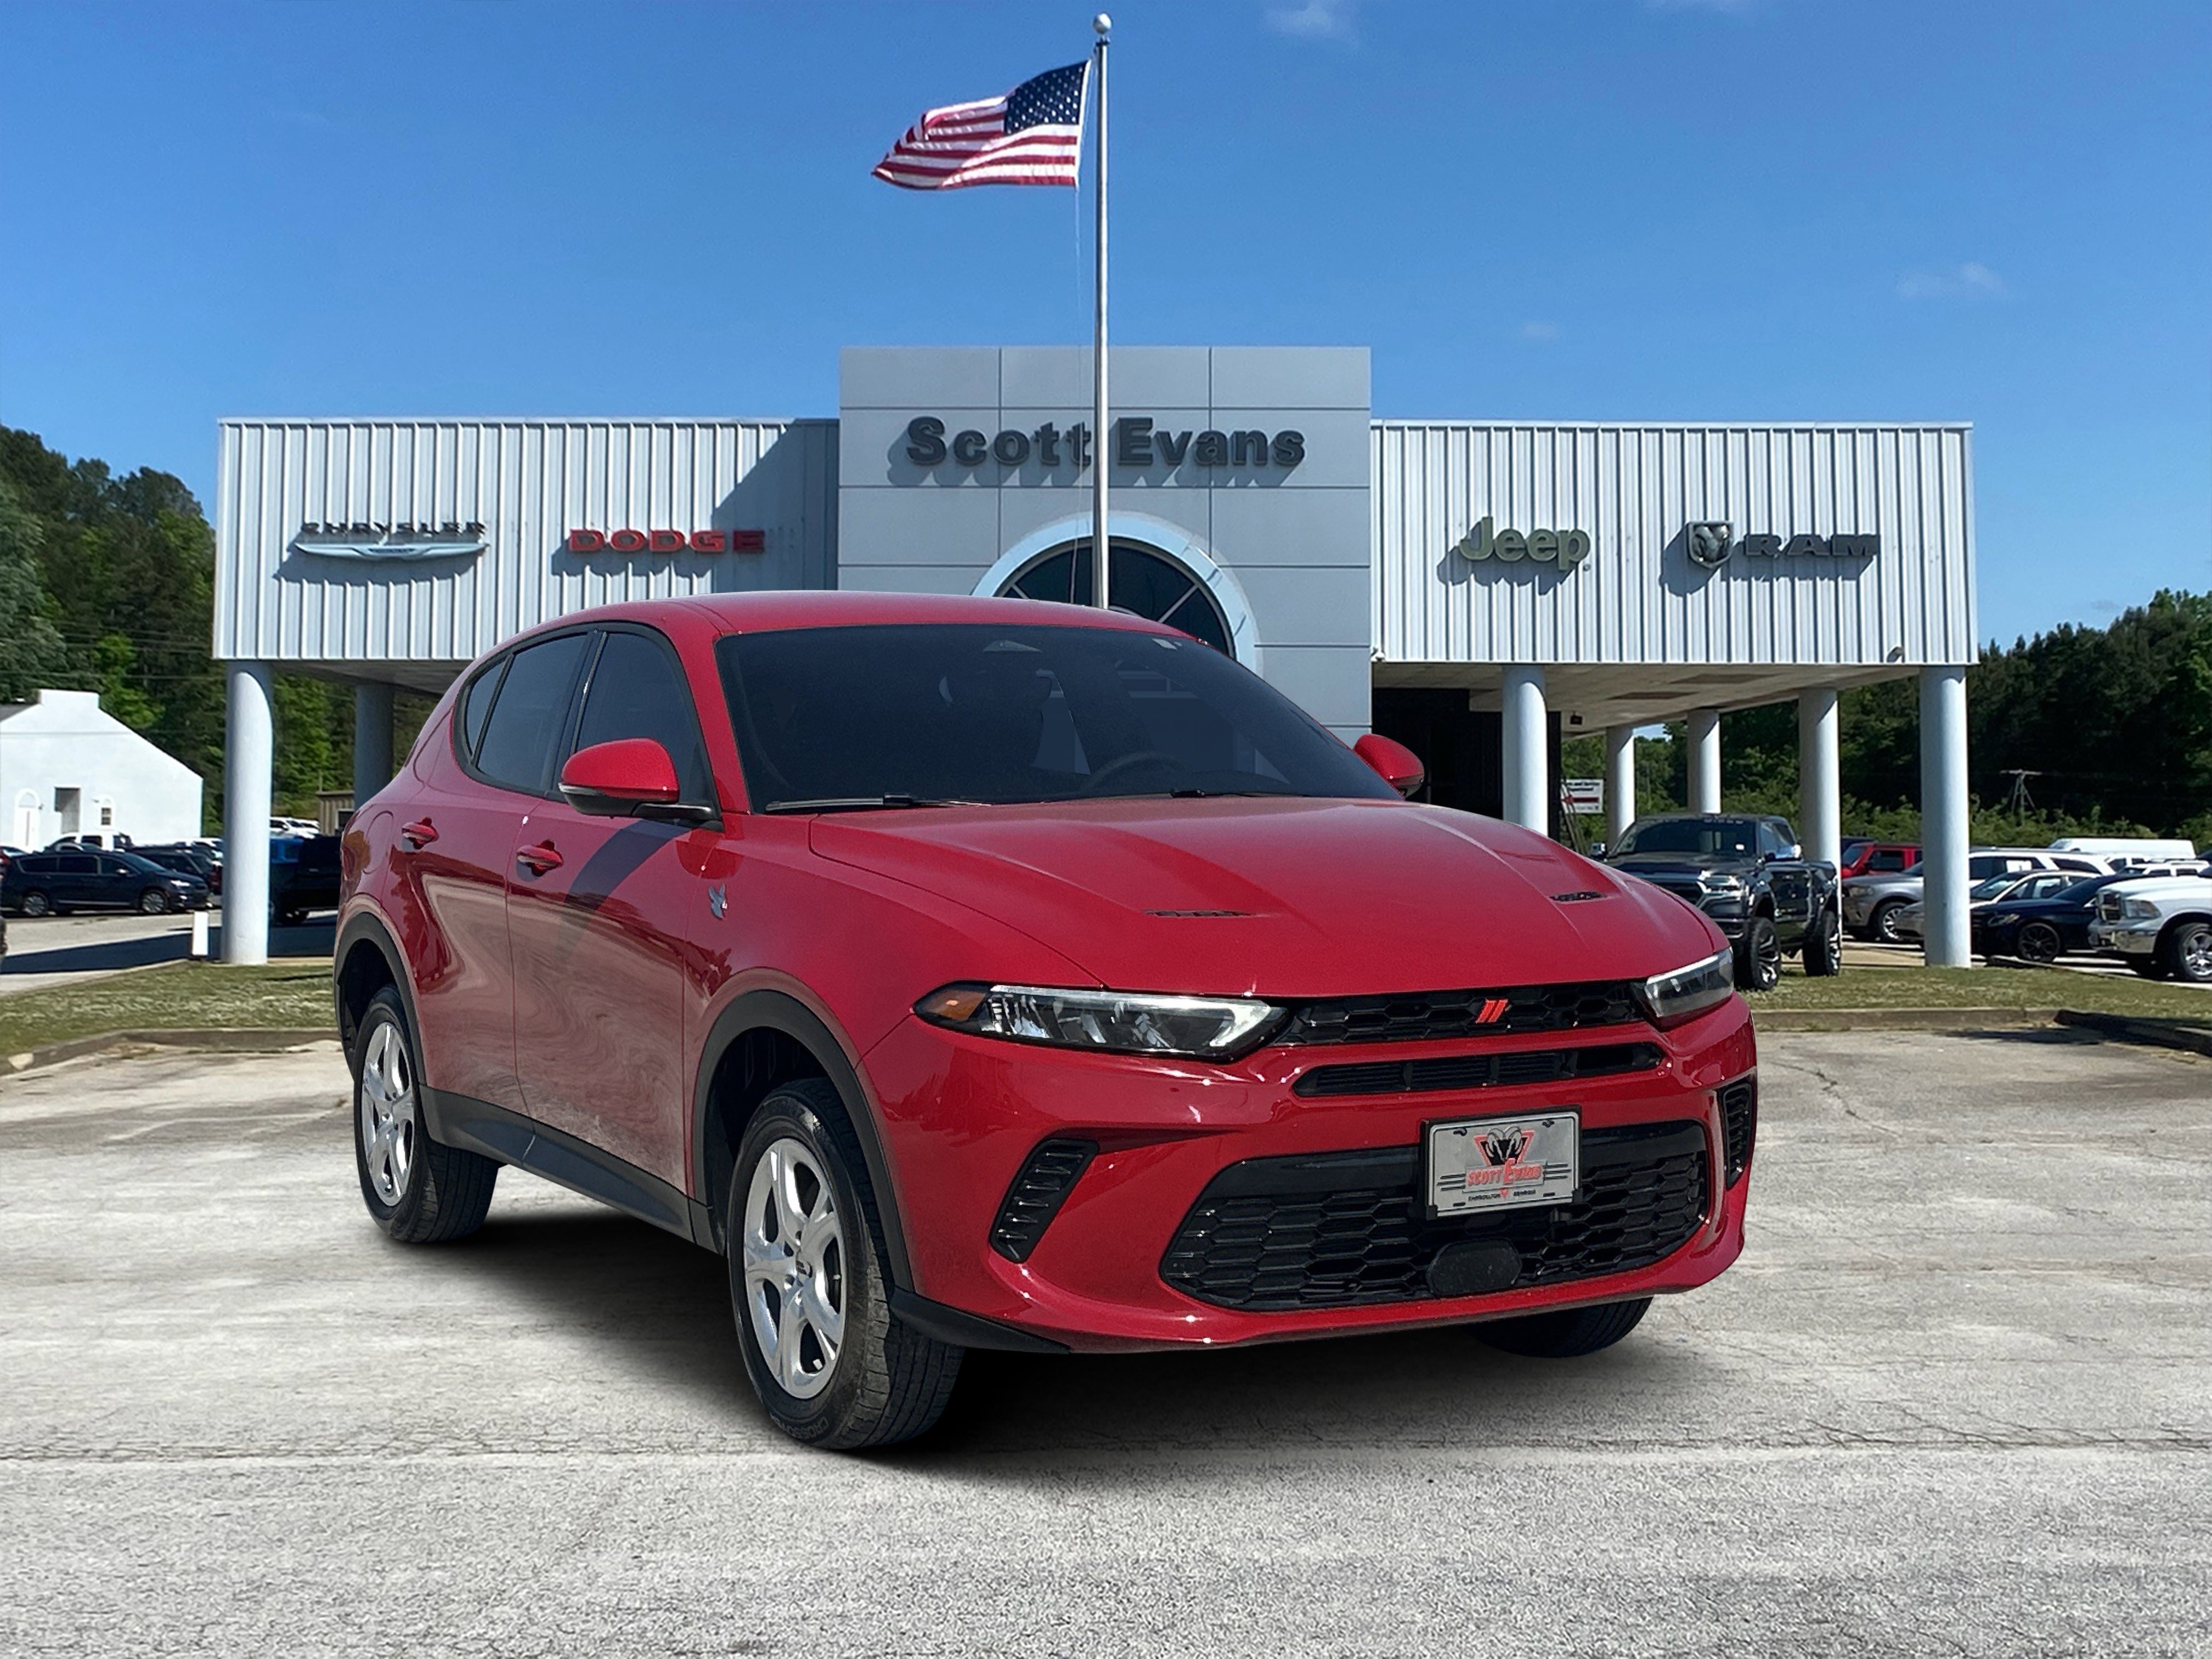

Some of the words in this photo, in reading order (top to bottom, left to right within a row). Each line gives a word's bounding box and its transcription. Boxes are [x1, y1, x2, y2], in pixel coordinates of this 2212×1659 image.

[906, 416, 1092, 466] Scott
[1117, 417, 1306, 466] Evans
[301, 521, 487, 535] CHRYSLER
[569, 529, 765, 552] DODGE
[1459, 516, 1590, 571] Jeep
[1744, 534, 1881, 556] RAM
[1468, 1167, 1502, 1187] SCOTT
